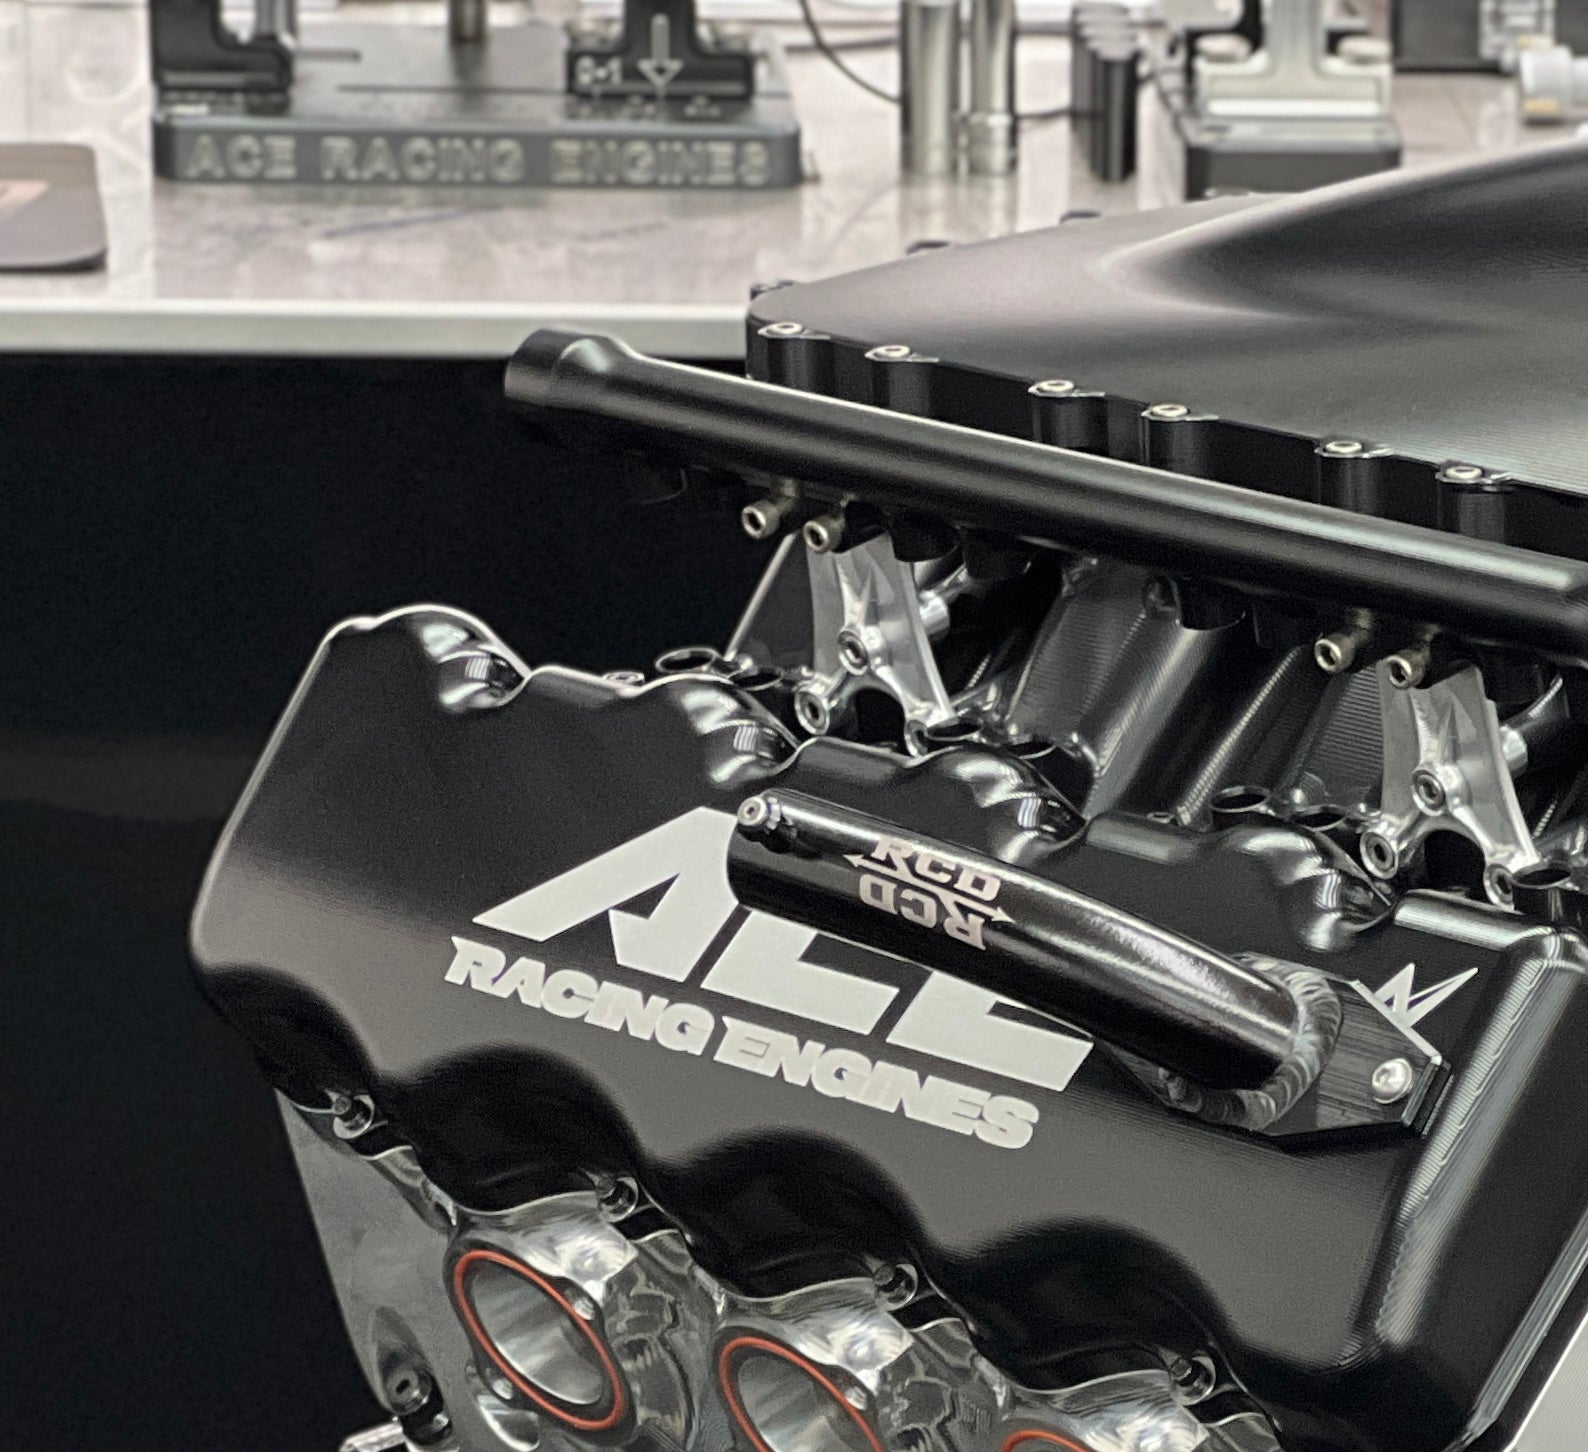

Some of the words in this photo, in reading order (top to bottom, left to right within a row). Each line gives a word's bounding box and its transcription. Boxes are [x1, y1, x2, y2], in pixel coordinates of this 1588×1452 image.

[183, 134, 298, 179] ACE
[322, 136, 526, 182] RACING
[550, 139, 774, 186] ENGINES
[870, 832, 1001, 902] RCD
[859, 873, 987, 951] RCD
[444, 935, 716, 1056] RACING
[693, 1015, 1040, 1150] ENGINES
